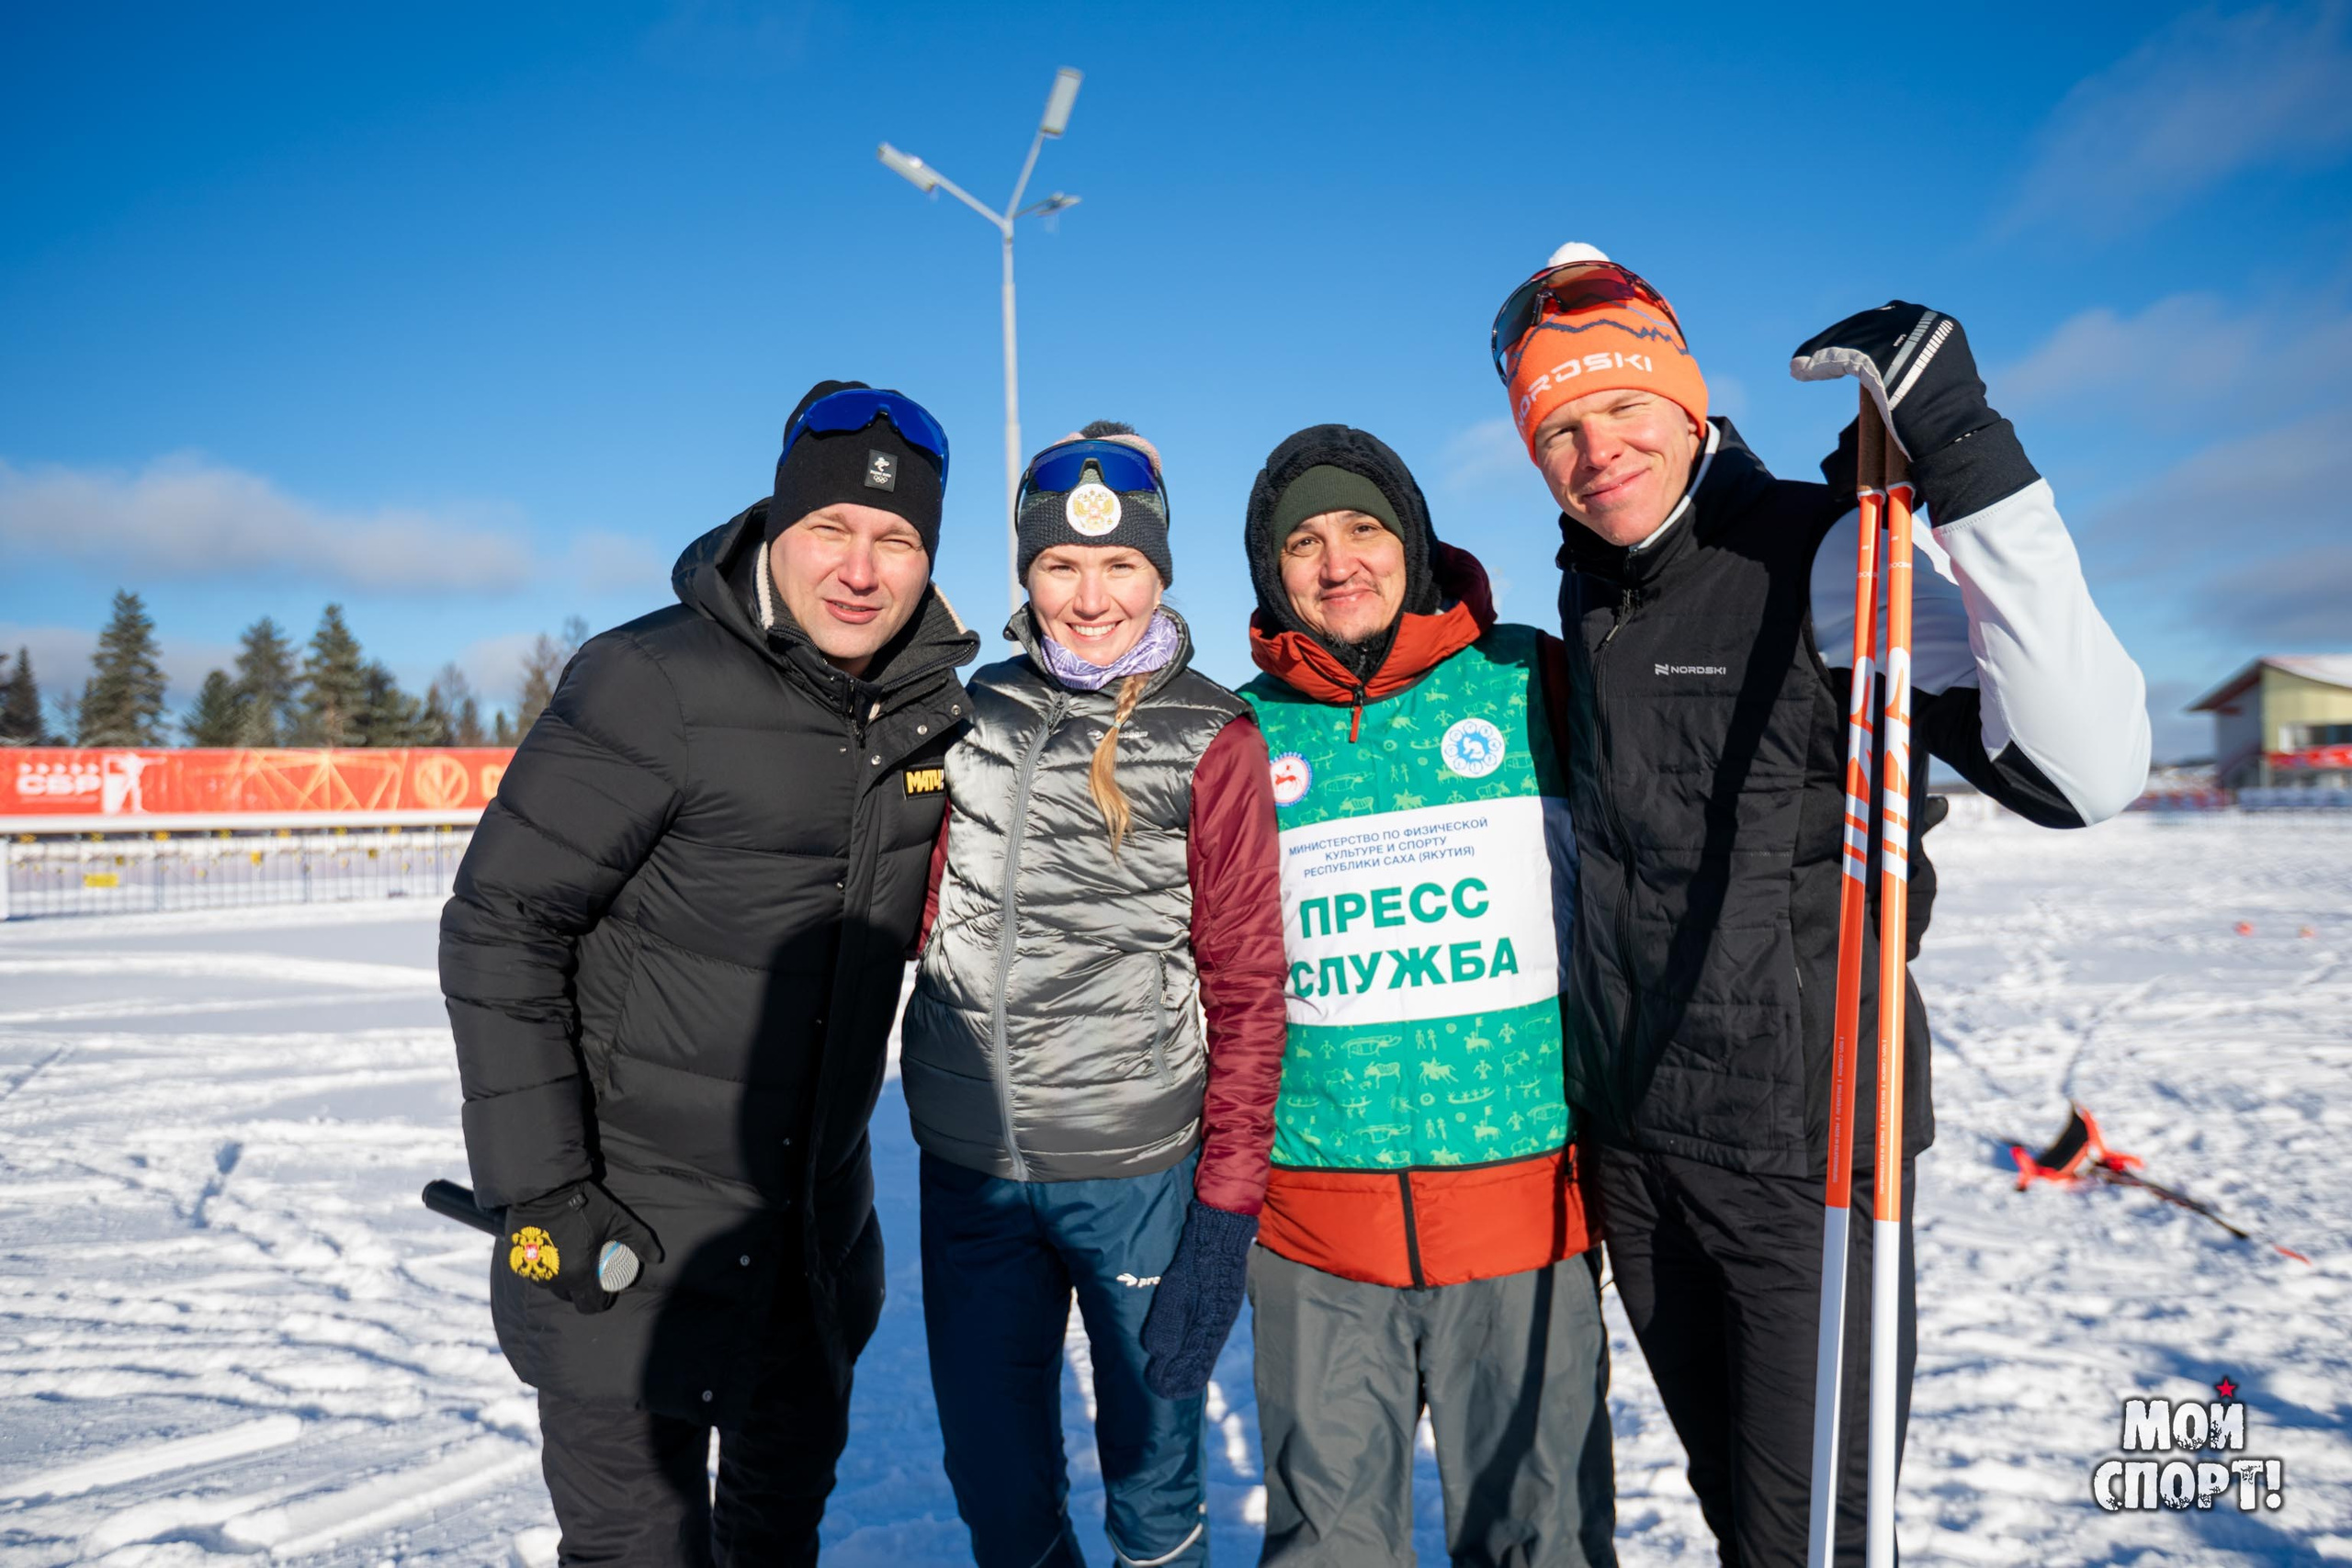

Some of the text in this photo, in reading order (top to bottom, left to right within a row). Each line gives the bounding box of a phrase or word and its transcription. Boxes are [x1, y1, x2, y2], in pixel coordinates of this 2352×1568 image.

[1670, 666, 1726, 675] NORDSKI
[1288, 817, 1488, 856] МИНИСТЕРСТВО ПО ФИЗИЧЕСКОЙ
[1325, 836, 1447, 861] КУЛЬТУРЕ И СПОРТУ
[1304, 845, 1475, 878] РЕСПУБЛИКИ САХА (ЯКУТИЯ)
[1299, 877, 1489, 939] ПРЕСС
[1291, 937, 1519, 998] СЛУЖБА
